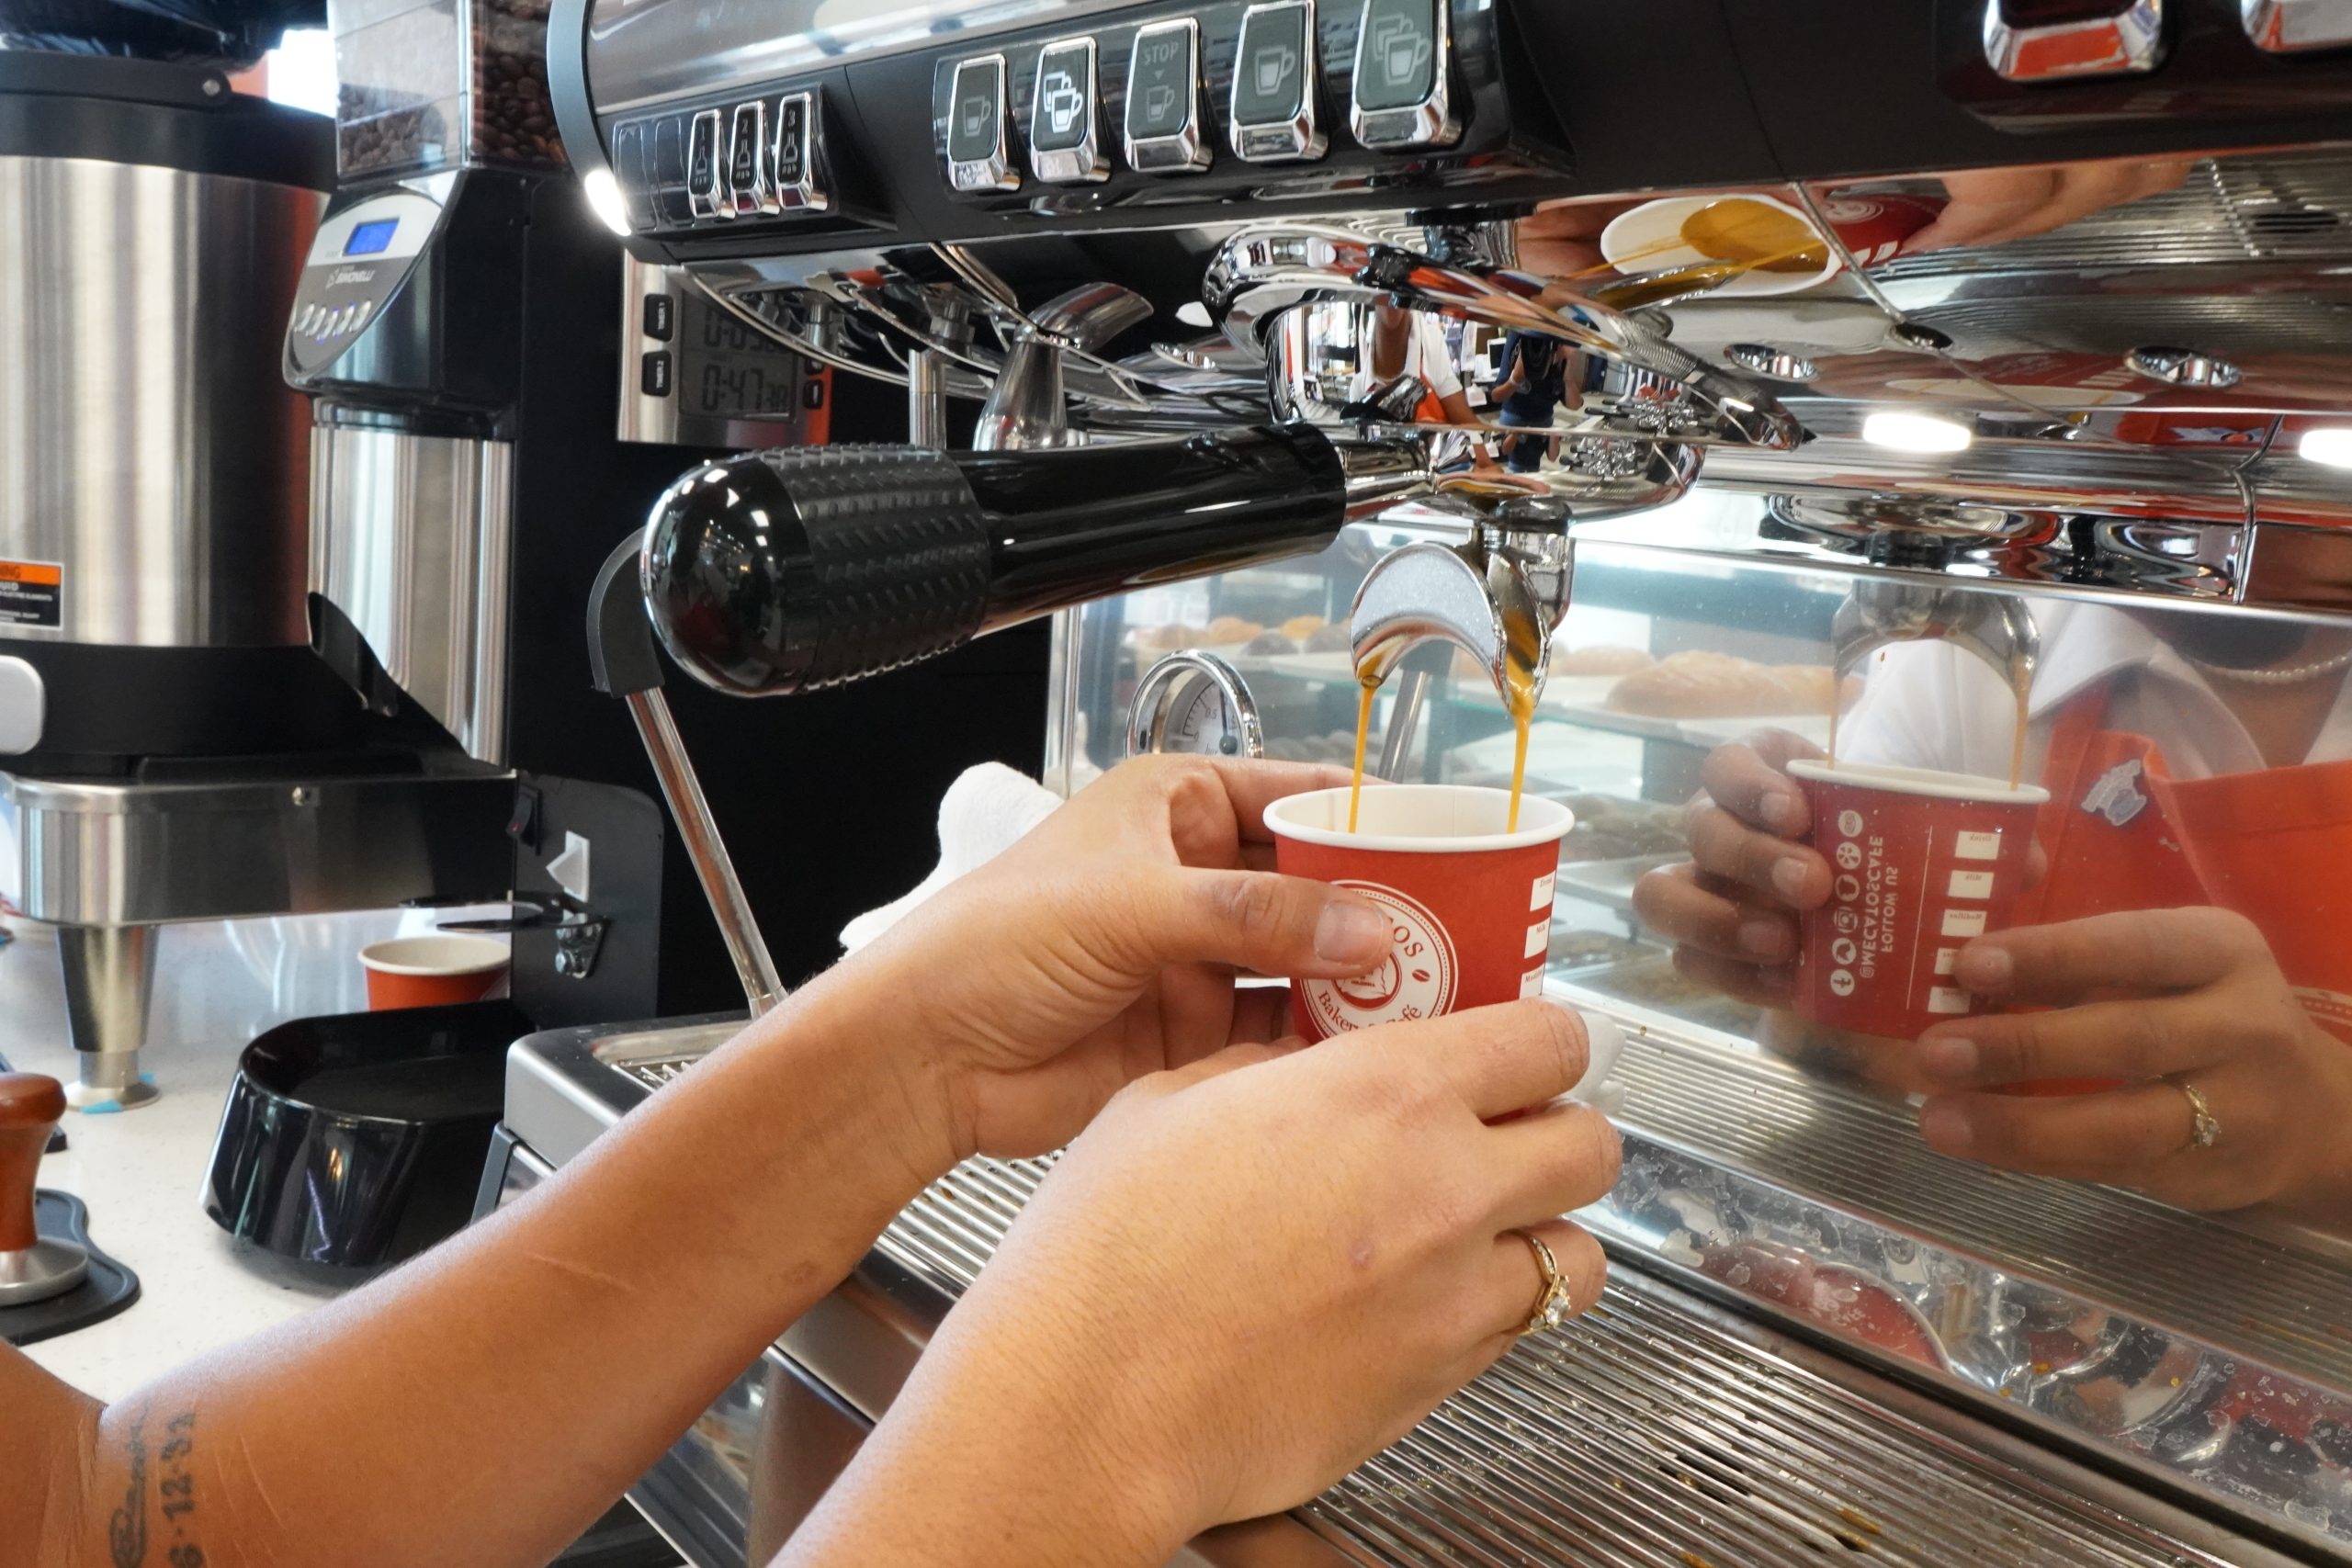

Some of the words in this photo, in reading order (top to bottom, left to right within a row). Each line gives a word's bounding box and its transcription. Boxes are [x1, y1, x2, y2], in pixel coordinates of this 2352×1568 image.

[1143, 41, 1179, 65] STOP
[741, 118, 750, 134] 2
[787, 108, 797, 127] 3
[1317, 990, 1360, 1031] Baker
